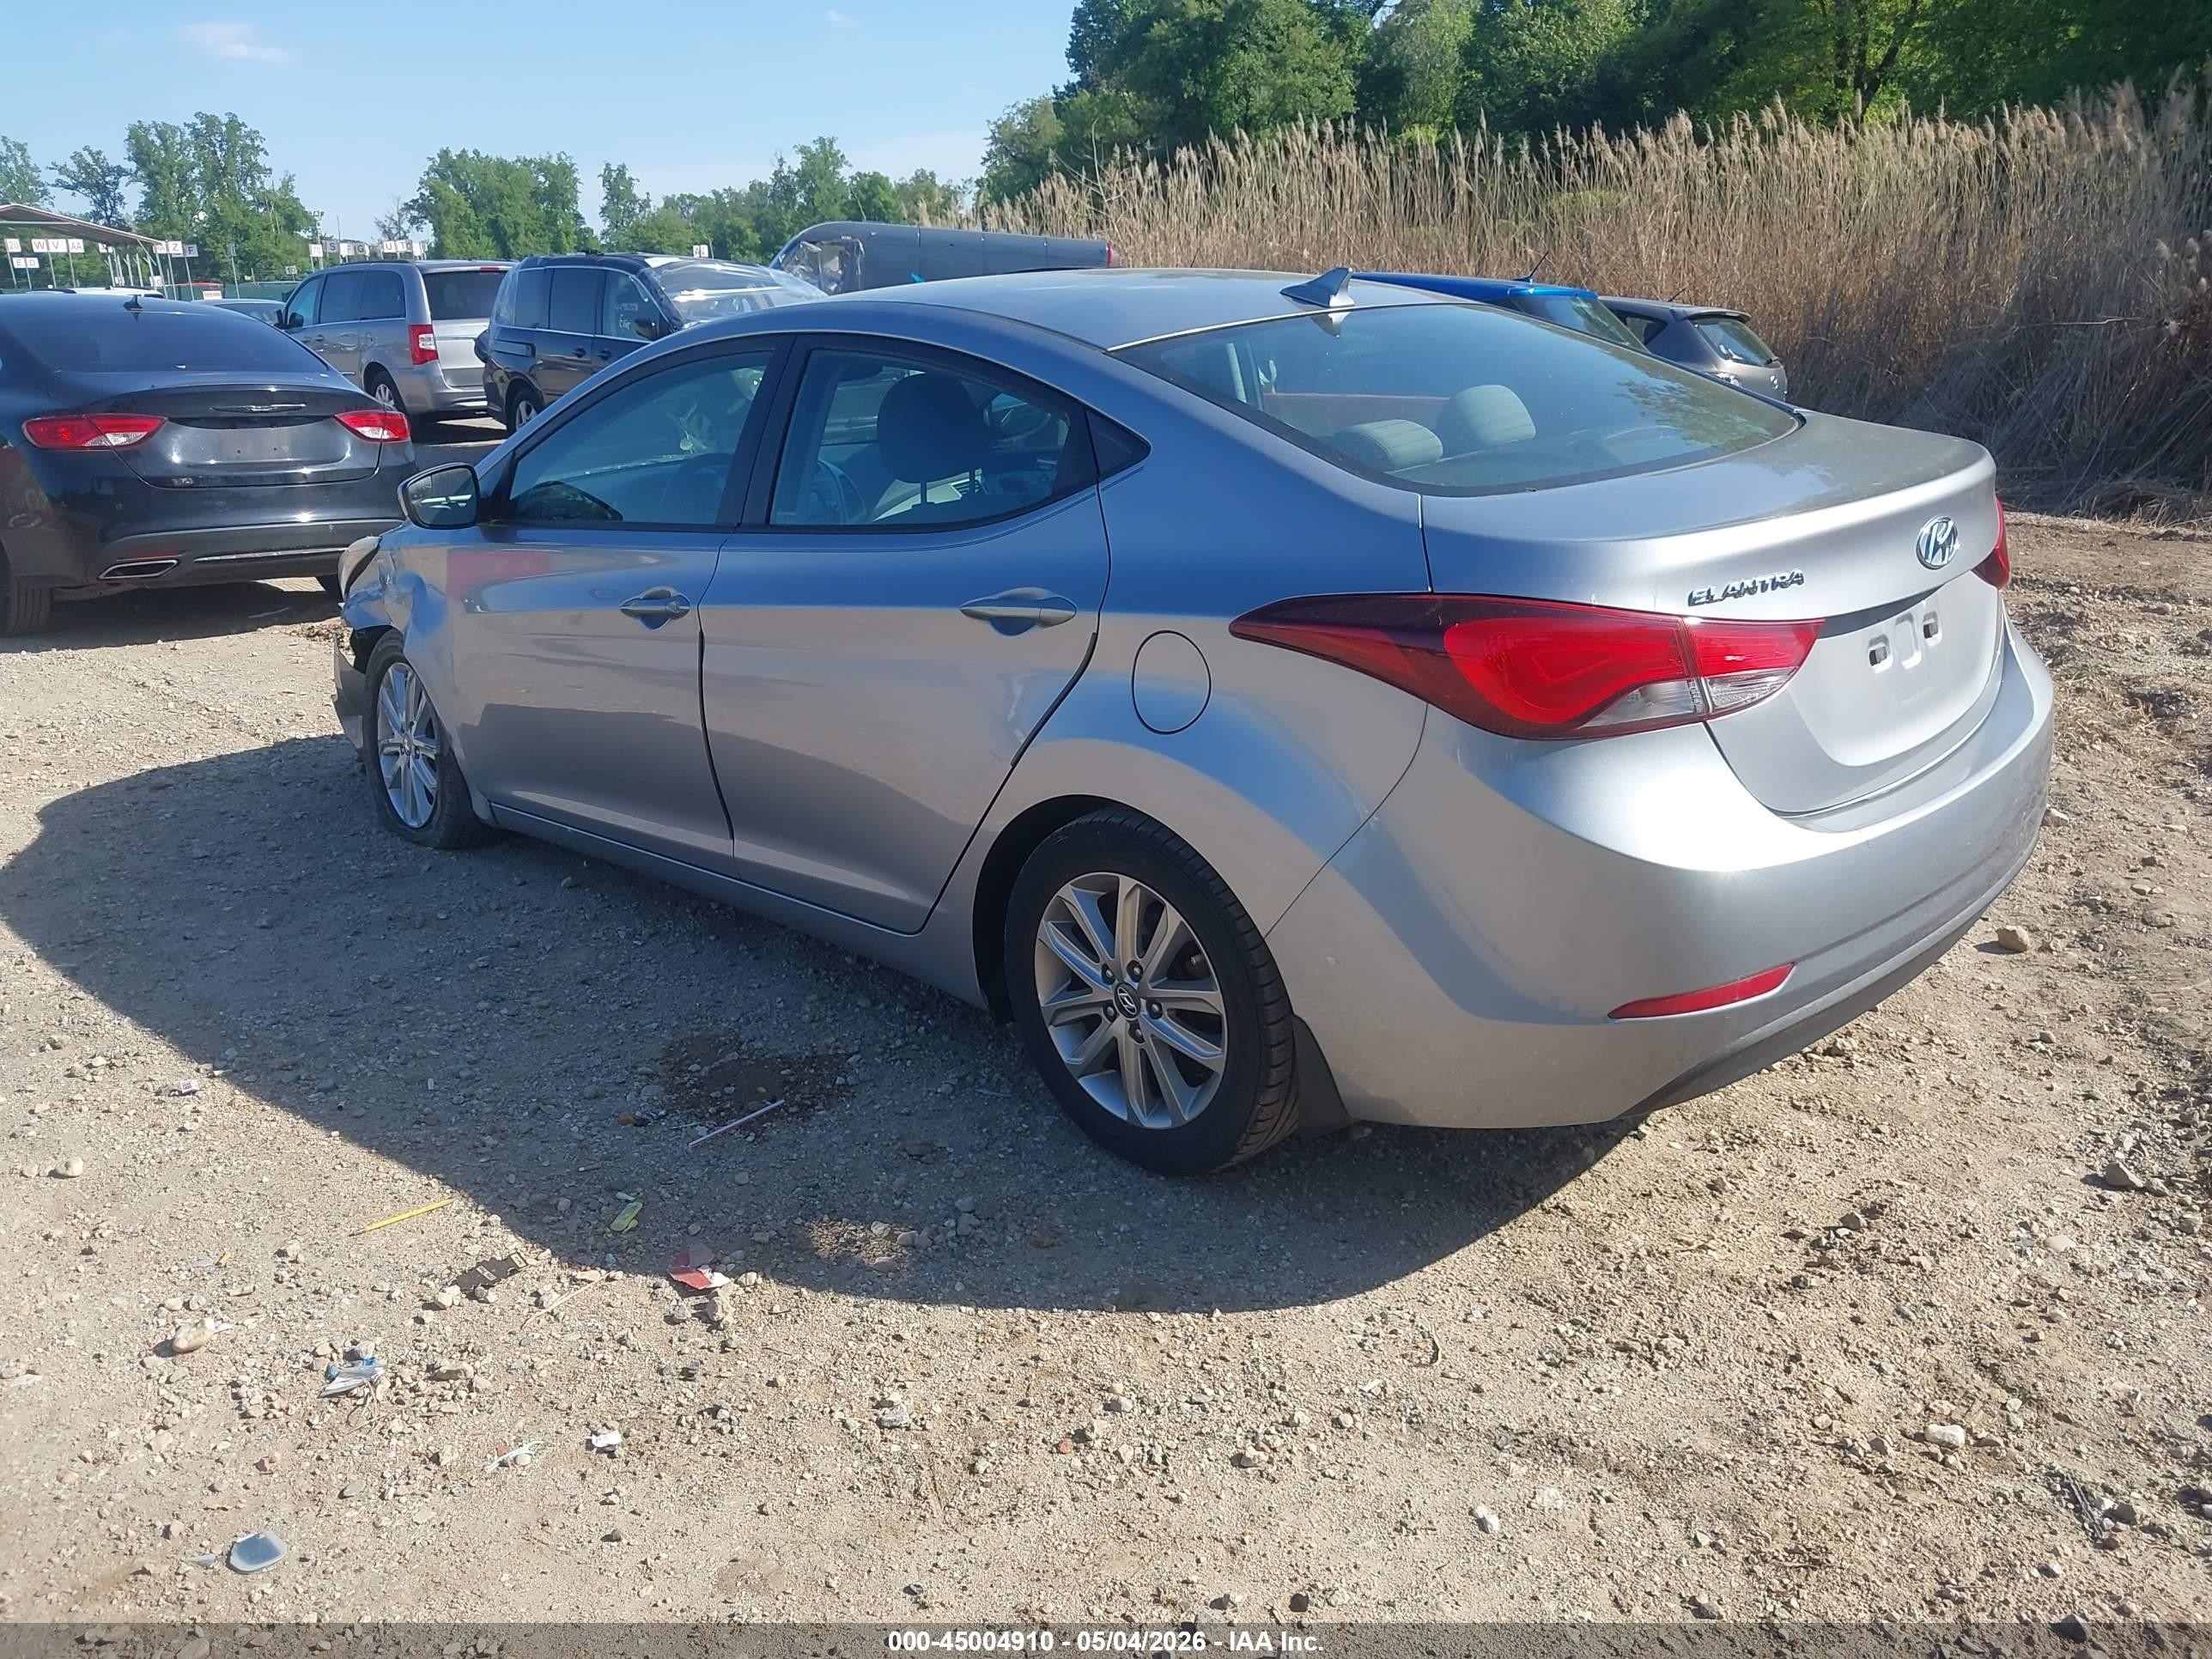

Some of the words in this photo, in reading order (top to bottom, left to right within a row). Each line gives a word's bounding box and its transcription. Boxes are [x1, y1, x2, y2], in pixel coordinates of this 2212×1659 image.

[33, 240, 45, 250] W
[52, 240, 59, 249] V
[172, 243, 179, 252] Z
[330, 242, 336, 251] S
[357, 244, 364, 252] G
[188, 246, 194, 255] F
[1687, 569, 1805, 606] ELANTRA
